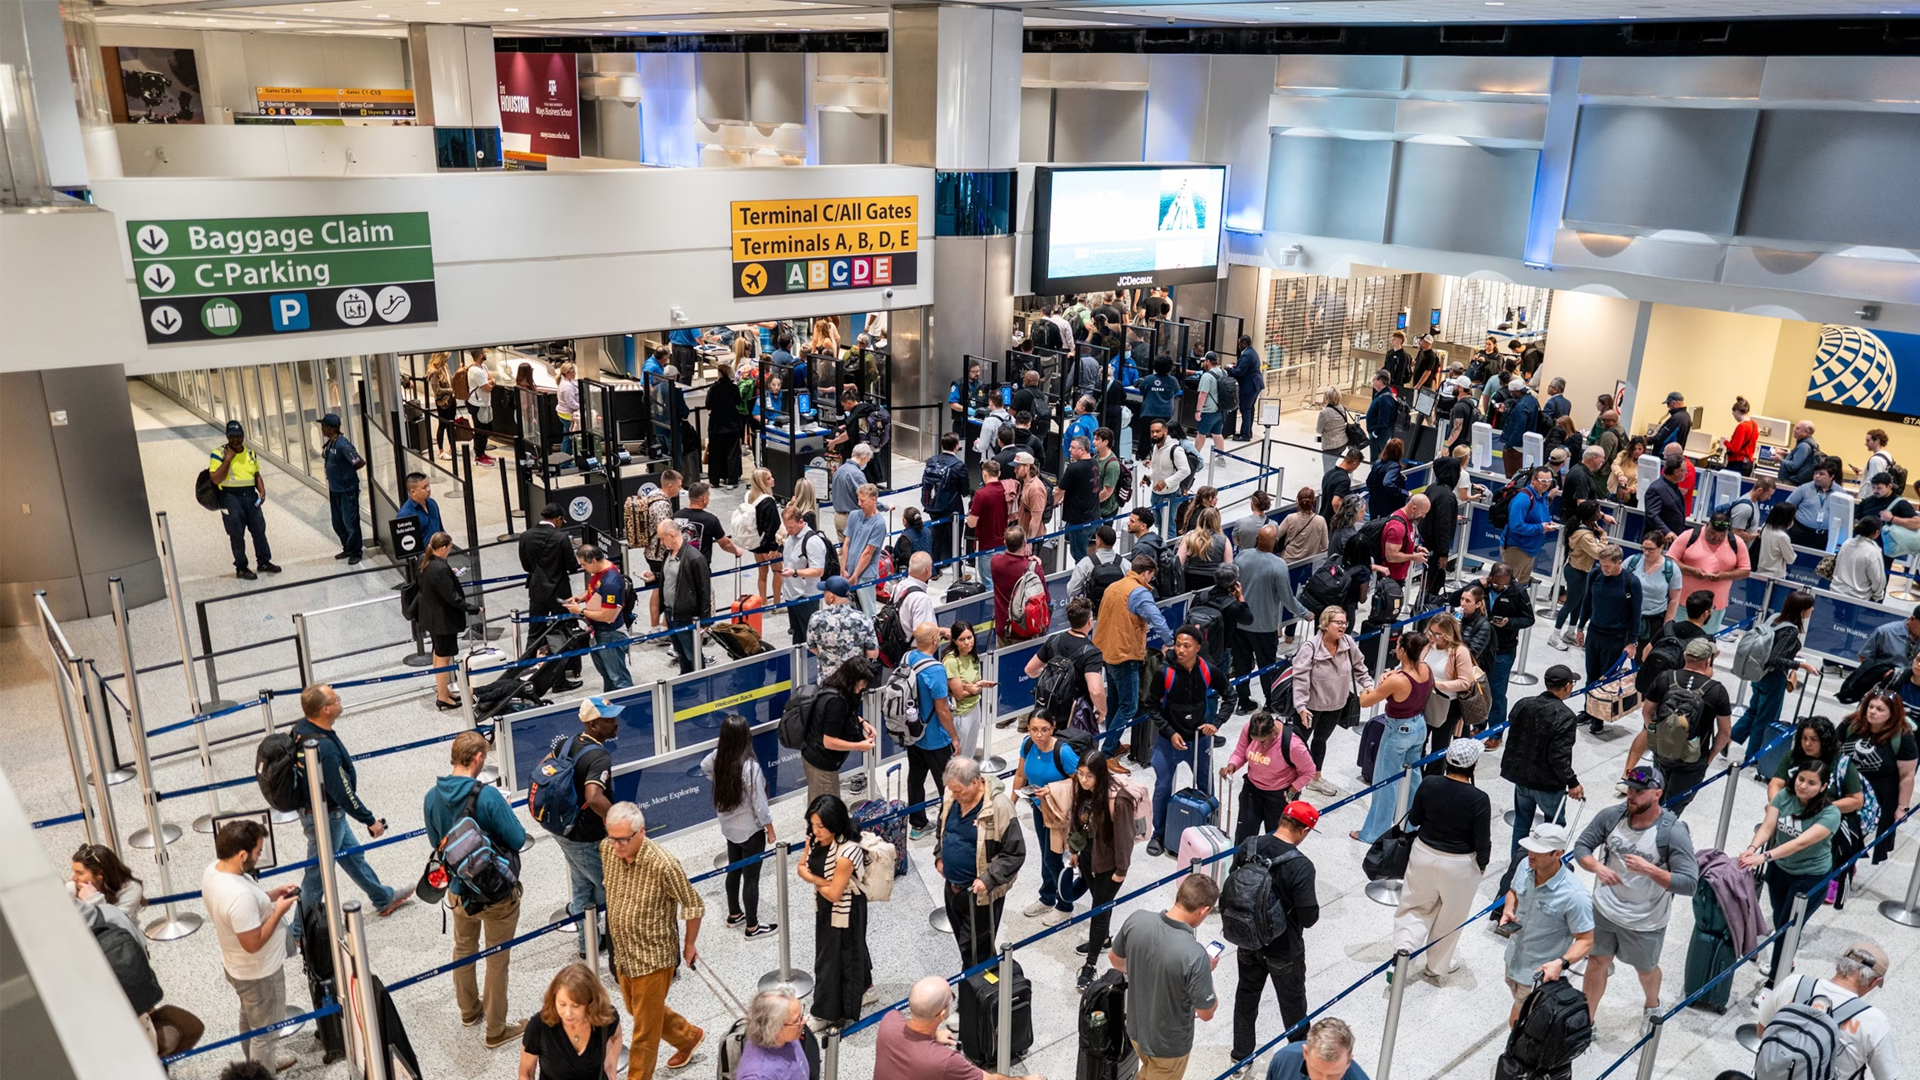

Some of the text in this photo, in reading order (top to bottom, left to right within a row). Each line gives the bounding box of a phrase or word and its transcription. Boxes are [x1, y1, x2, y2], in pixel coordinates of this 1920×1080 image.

[500, 95, 530, 113] HOUSTON
[545, 107, 560, 116] Business
[560, 108, 572, 117] School
[739, 202, 912, 225] Terminal C/All Gates
[188, 220, 394, 254] Baggage Claim
[740, 230, 910, 255] Terminals A, B, D, E
[195, 260, 330, 287] C-Parking
[788, 263, 804, 284] A
[811, 262, 826, 283] B
[832, 260, 848, 282] C
[854, 259, 869, 280] D
[875, 258, 889, 278] E
[1117, 275, 1153, 287] JCDecaux
[279, 299, 301, 325] P
[597, 532, 612, 547] Please
[1833, 624, 1846, 632] Less
[714, 693, 753, 709] Welcome Back
[1247, 750, 1271, 765] nike
[651, 796, 668, 805] More
[669, 786, 700, 799] Exploring
[480, 948, 497, 957] UNITED
[416, 972, 433, 981] UNITED
[277, 1019, 296, 1028] CLEAR
[165, 1053, 186, 1063] CLEAR
